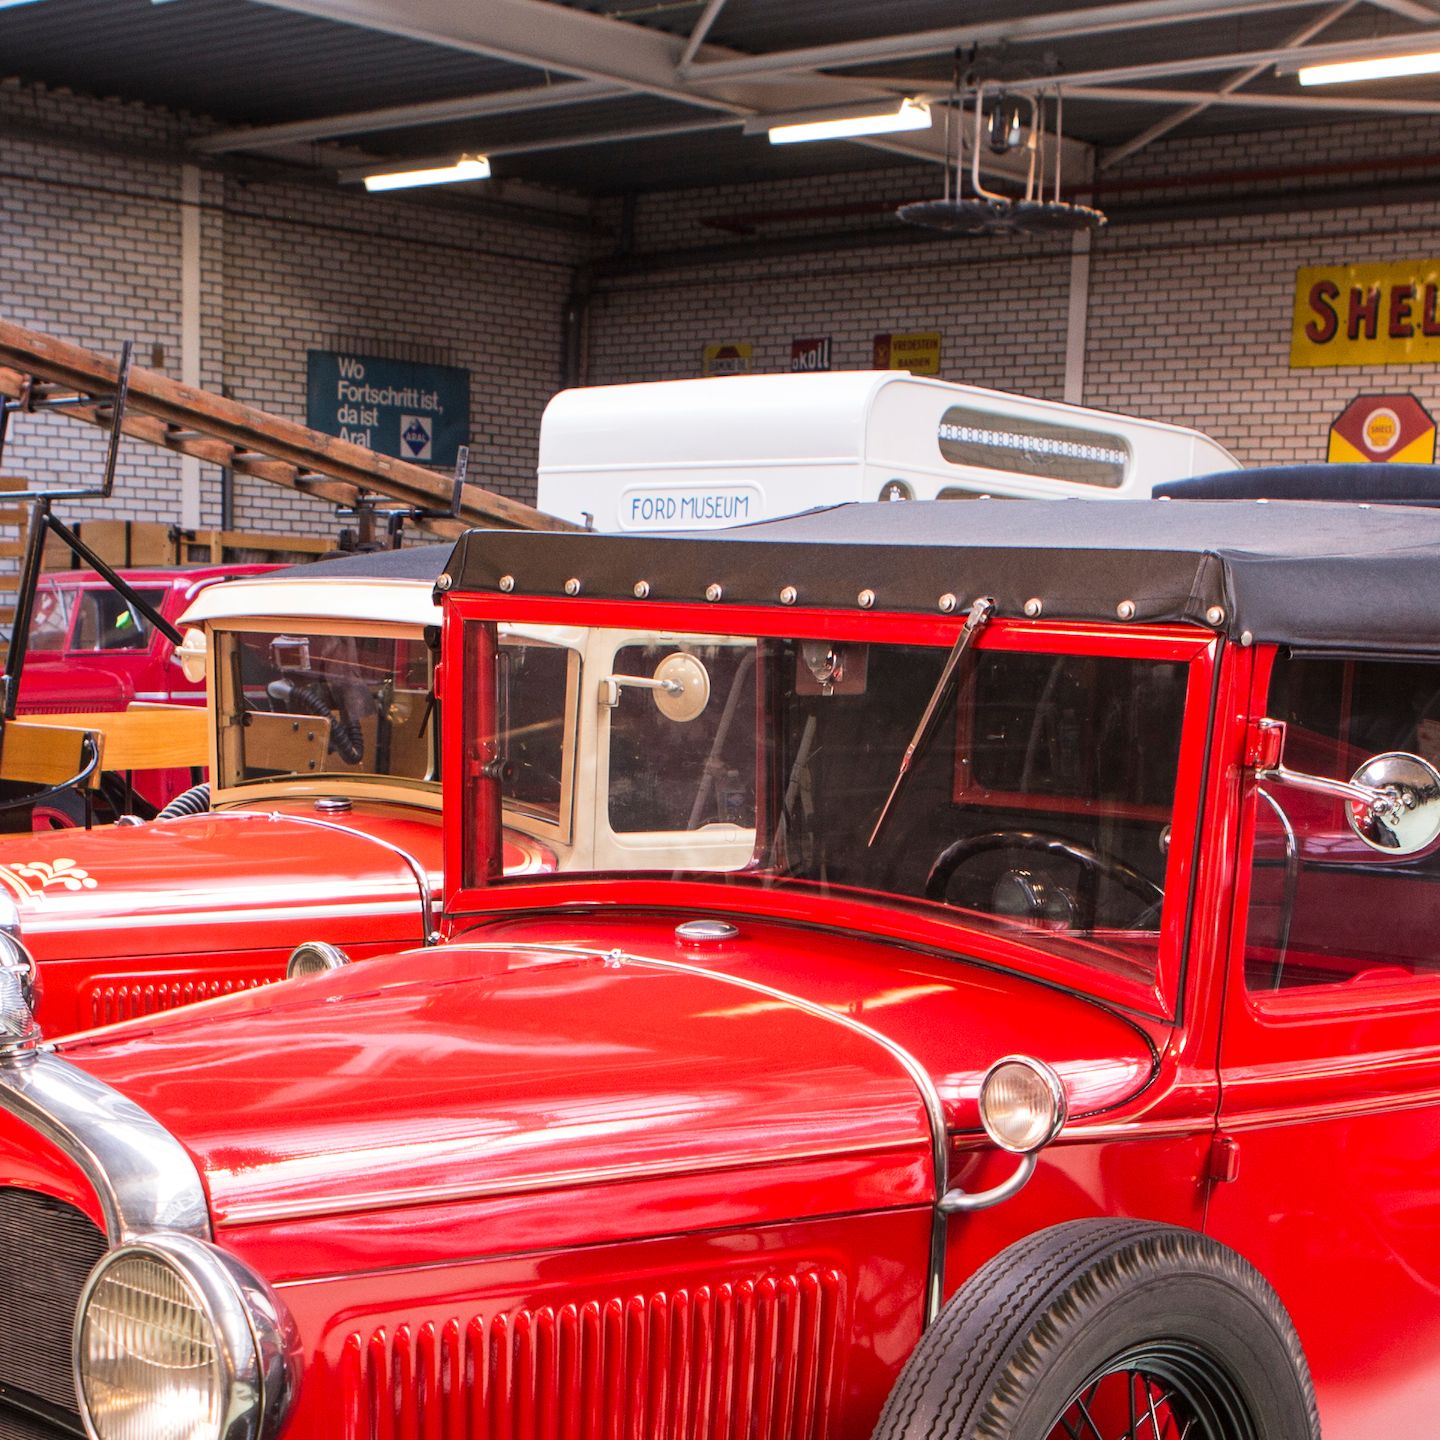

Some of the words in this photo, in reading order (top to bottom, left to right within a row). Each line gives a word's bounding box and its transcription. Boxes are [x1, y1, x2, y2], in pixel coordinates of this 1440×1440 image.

[338, 356, 365, 379] Wo
[337, 380, 418, 408] Fortschritt
[421, 389, 444, 414] ist,
[337, 403, 358, 425] da
[360, 406, 378, 427] ist
[339, 427, 371, 449] Aral
[406, 434, 426, 442] ARAL
[632, 497, 677, 520] FORD
[681, 496, 749, 519] MUSEUM
